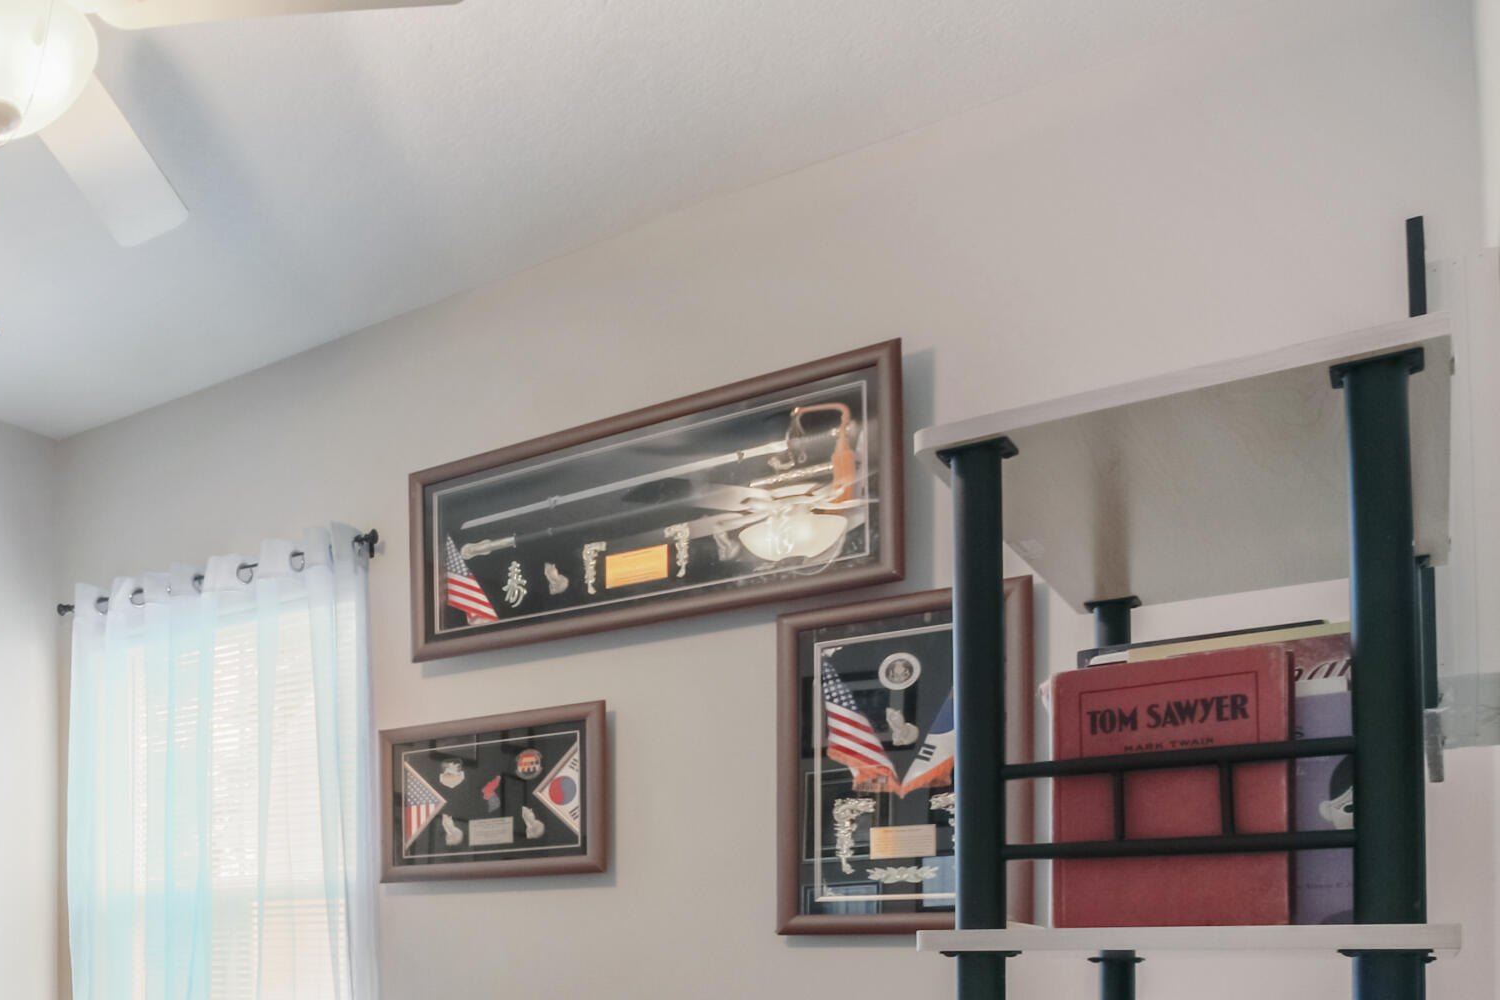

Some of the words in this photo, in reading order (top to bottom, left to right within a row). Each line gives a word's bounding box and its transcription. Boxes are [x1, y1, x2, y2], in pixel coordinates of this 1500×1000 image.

[1086, 707, 1139, 736] TOM
[1146, 693, 1250, 730] SAWYER
[1122, 742, 1164, 753] MARK
[1168, 736, 1215, 749] TWAIN
